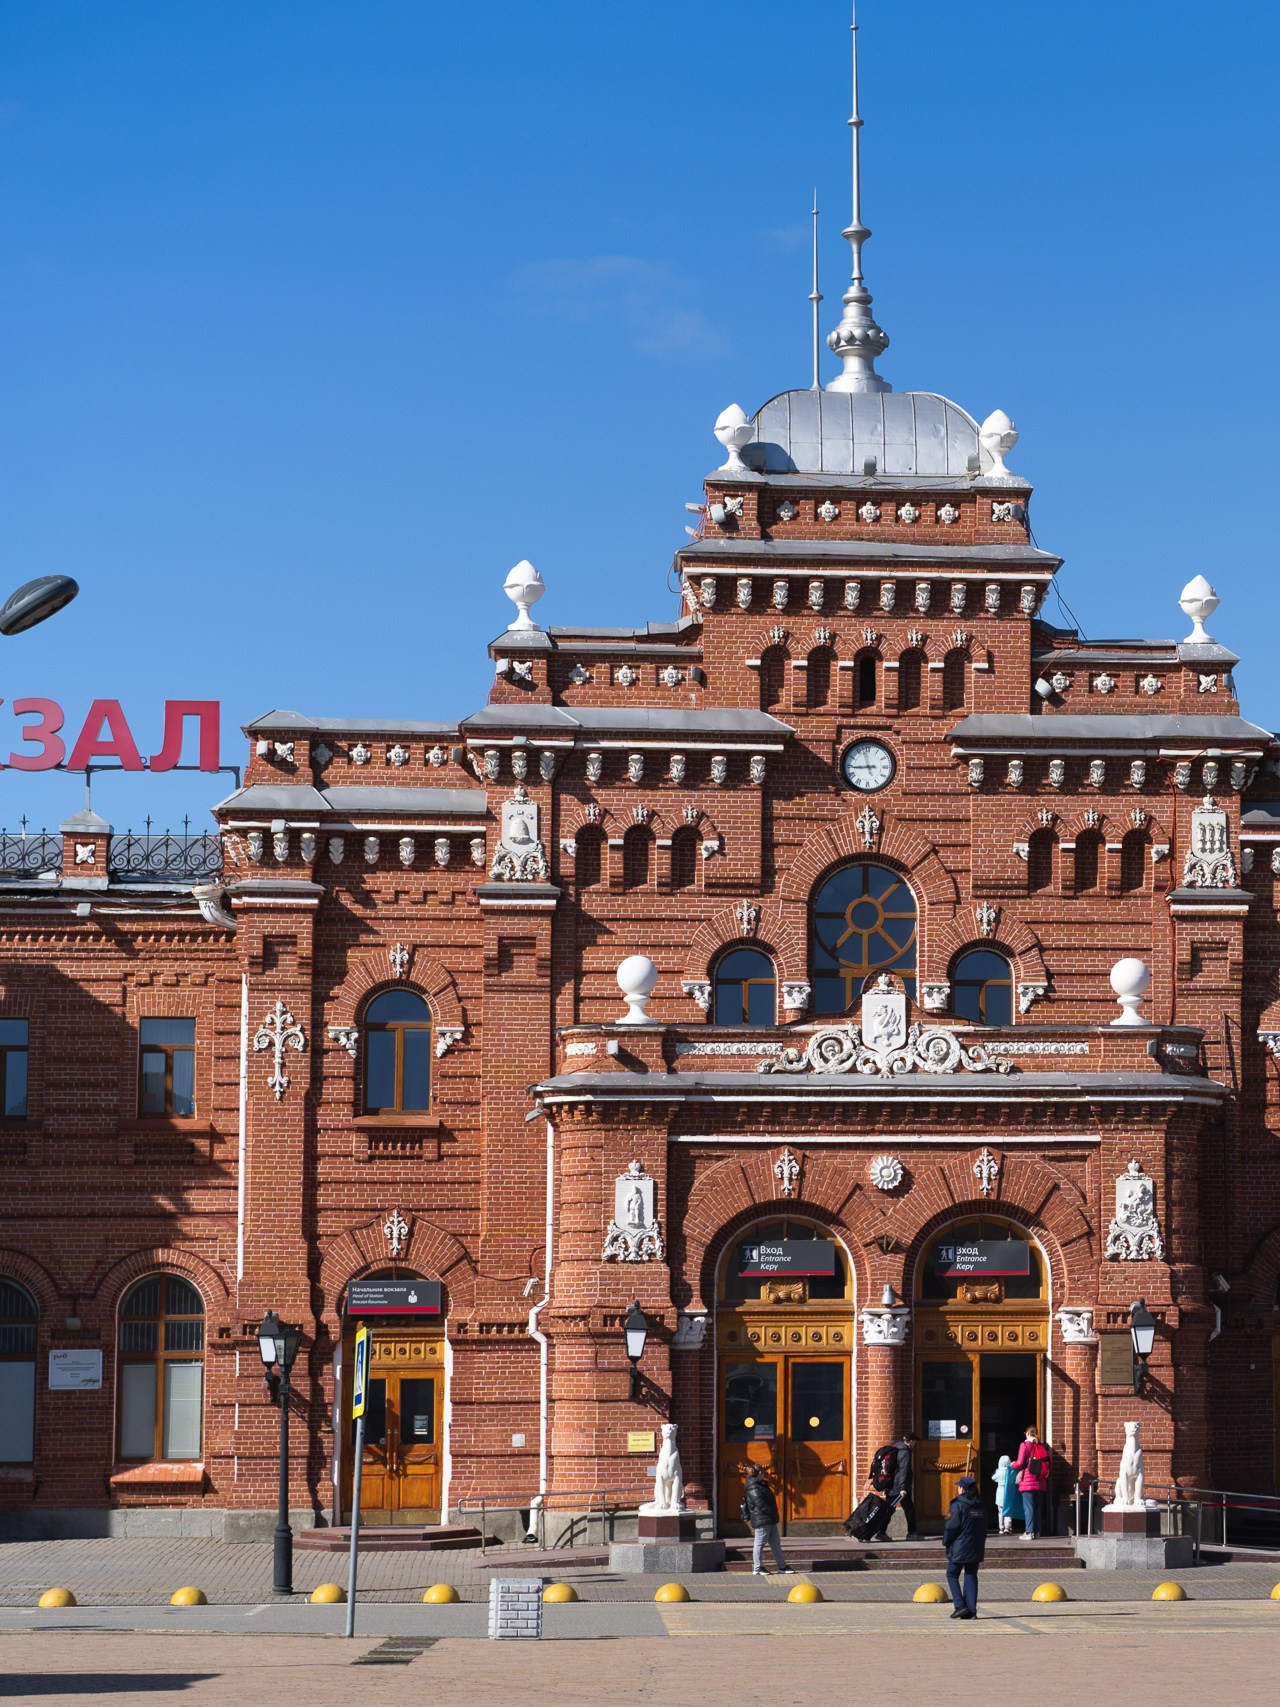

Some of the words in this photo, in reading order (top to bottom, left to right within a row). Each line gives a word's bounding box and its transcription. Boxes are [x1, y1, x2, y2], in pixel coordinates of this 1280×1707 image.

[0, 698, 220, 772] ЗАЛ
[760, 1245, 783, 1255] Вход
[956, 1246, 979, 1255] Вход
